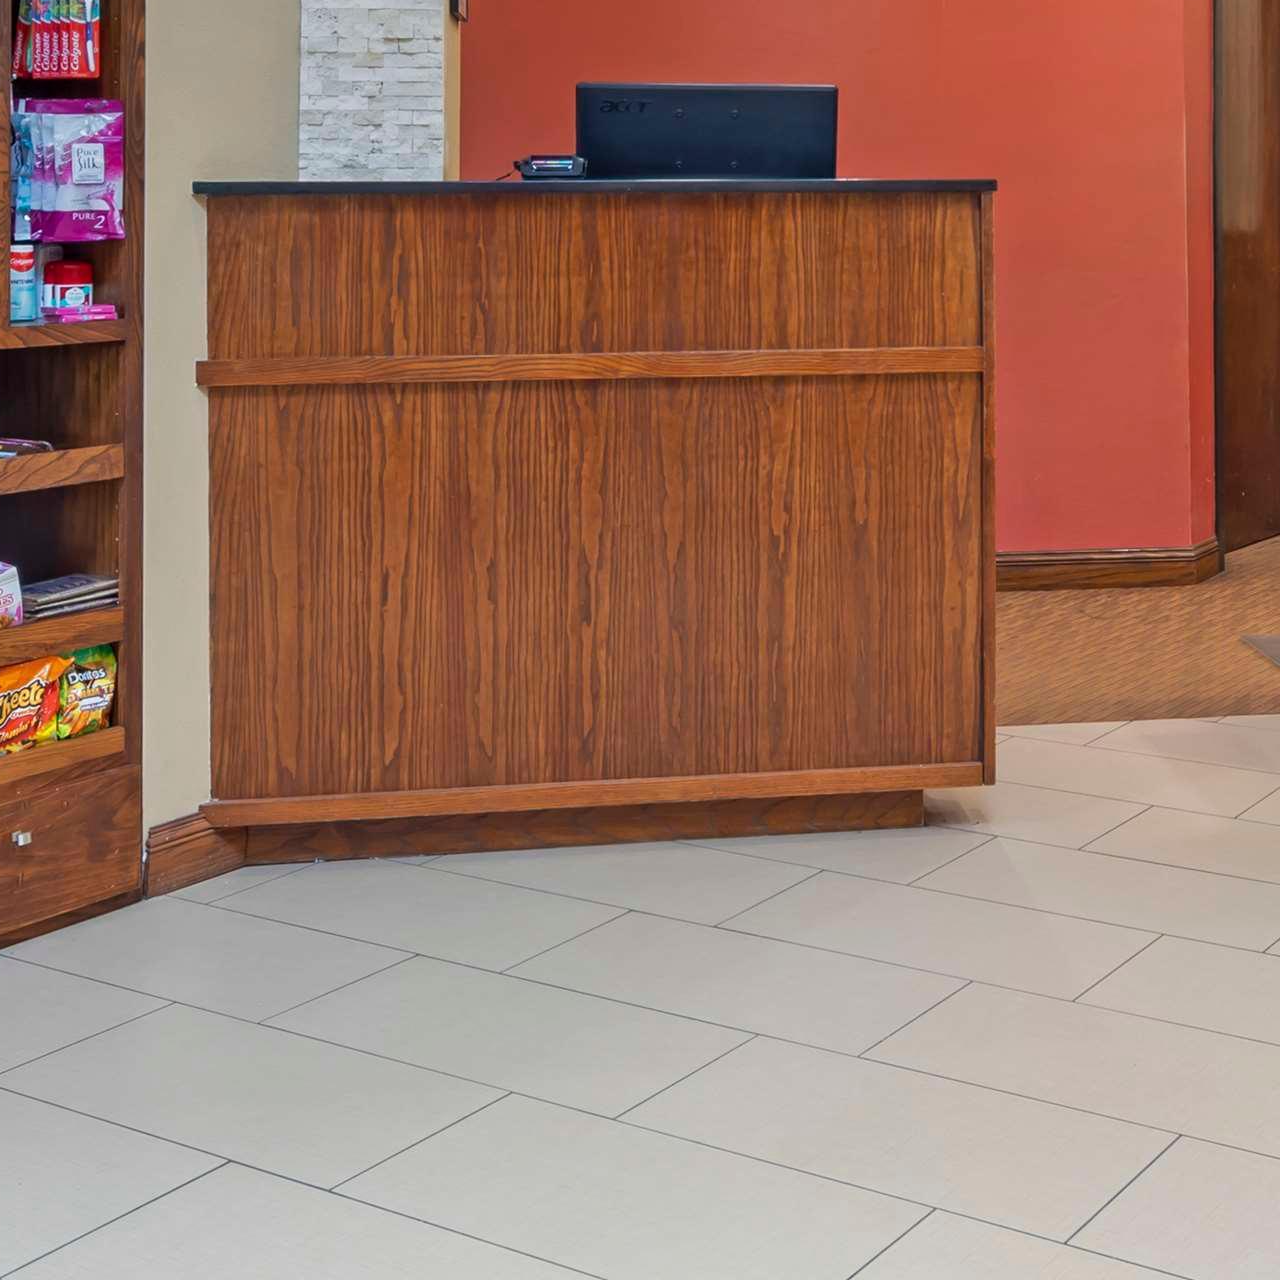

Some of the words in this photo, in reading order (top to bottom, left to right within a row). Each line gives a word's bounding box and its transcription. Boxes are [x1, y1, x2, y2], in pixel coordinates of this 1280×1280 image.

[60, 31, 70, 71] Colgate
[70, 31, 81, 71] Colgate
[599, 99, 652, 114] acer
[72, 212, 96, 221] PURE
[94, 215, 106, 229] 2
[67, 667, 107, 685] Doritos
